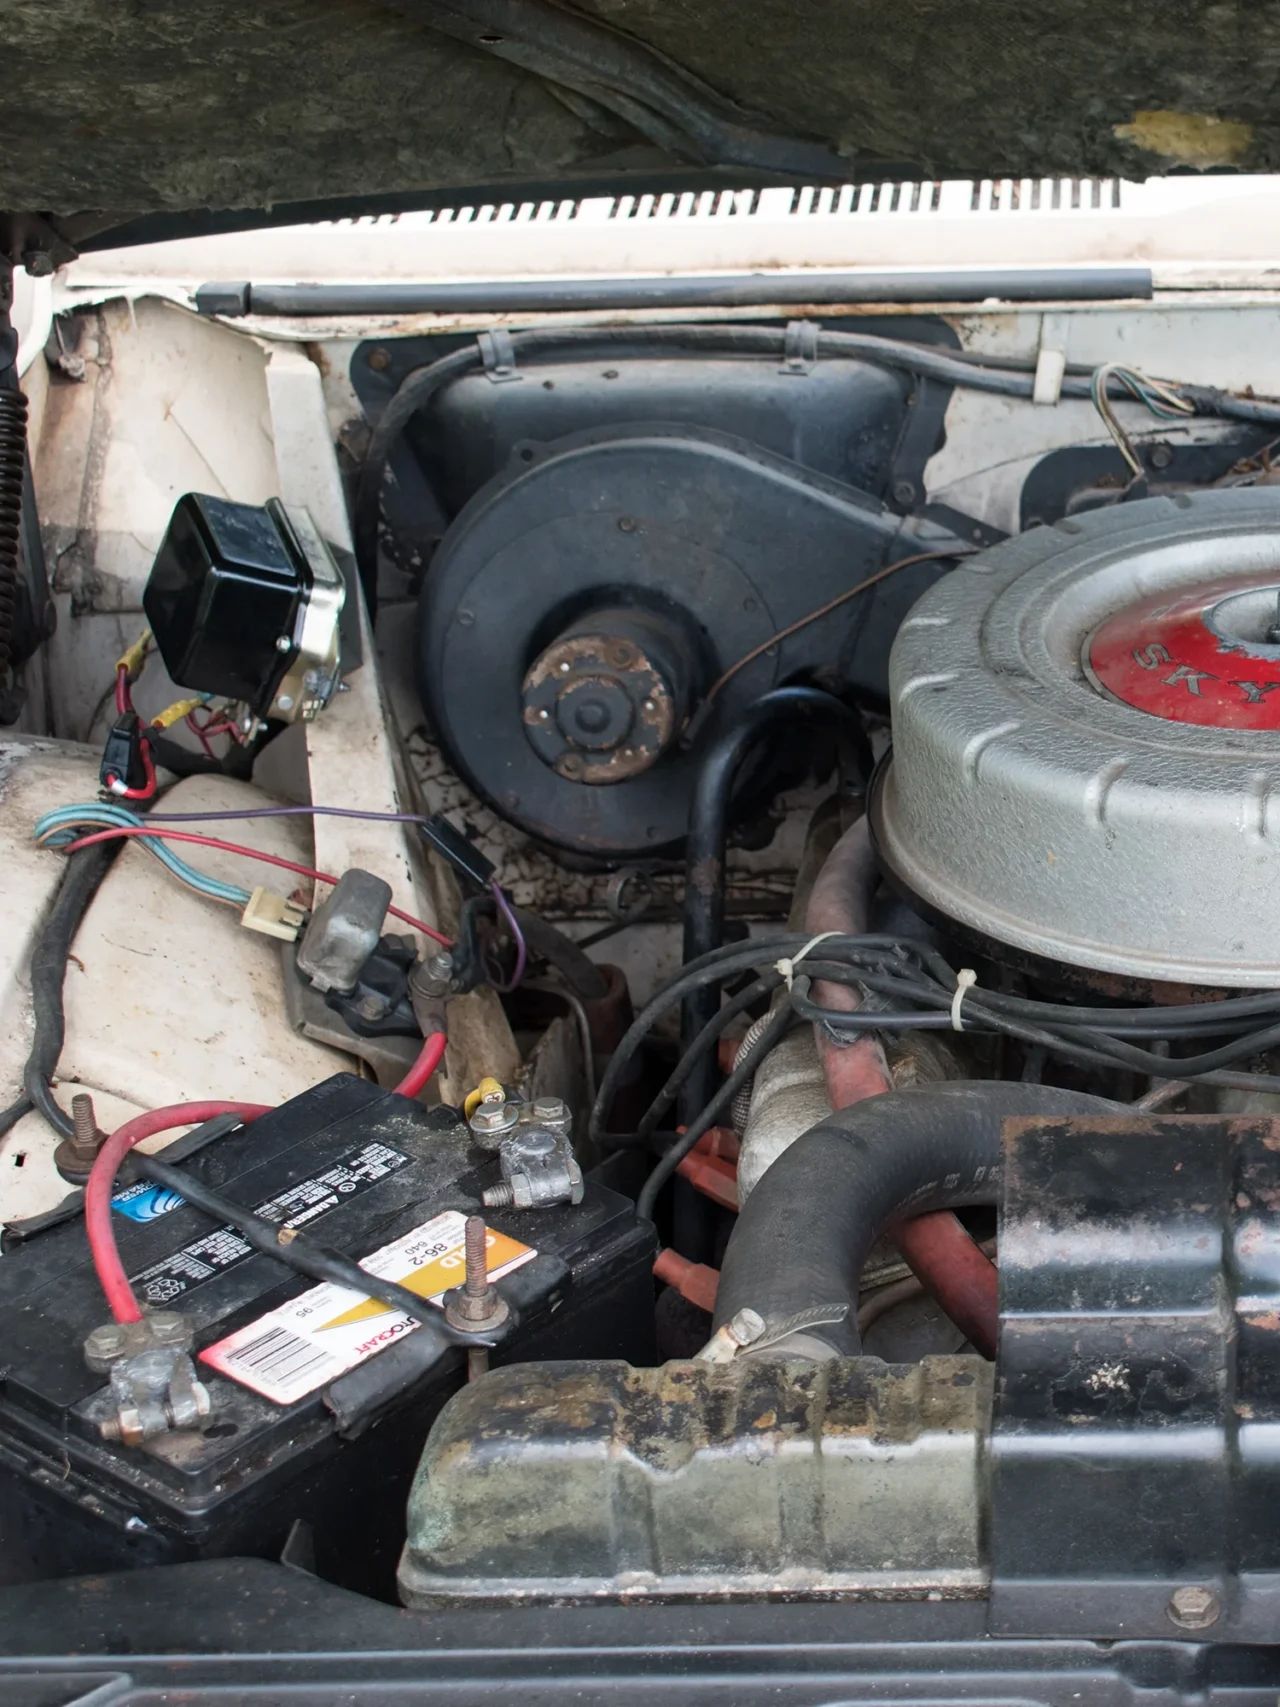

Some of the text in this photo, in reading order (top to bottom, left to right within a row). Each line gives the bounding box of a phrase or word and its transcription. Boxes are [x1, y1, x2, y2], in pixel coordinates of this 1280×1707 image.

[404, 1240, 427, 1256] 640
[408, 1242, 448, 1267] 86-2
[439, 1235, 496, 1269] GLD
[296, 1306, 314, 1319] 95
[355, 1316, 416, 1355] UTOCRAFT
